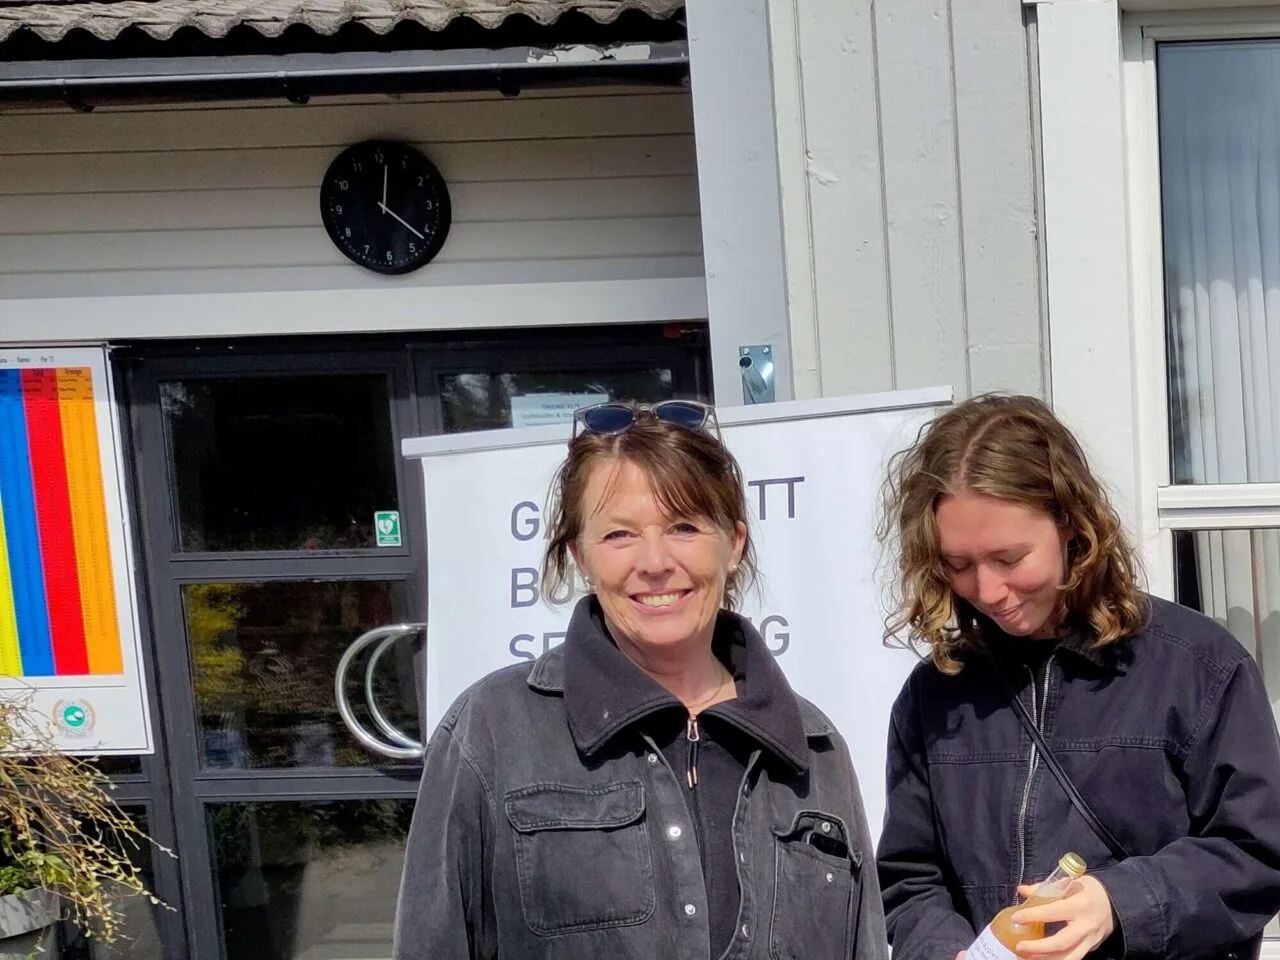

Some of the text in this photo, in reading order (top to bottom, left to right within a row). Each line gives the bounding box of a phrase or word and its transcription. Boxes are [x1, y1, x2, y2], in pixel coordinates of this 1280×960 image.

[374, 153, 384, 163] 12
[339, 180, 349, 191] 10
[417, 176, 423, 187] 2
[336, 205, 343, 215] 9
[426, 200, 432, 210] 3
[345, 227, 351, 237] 8
[424, 224, 430, 233] 4
[364, 245, 370, 254] 7
[409, 243, 416, 253] 5
[386, 251, 393, 260] 6
